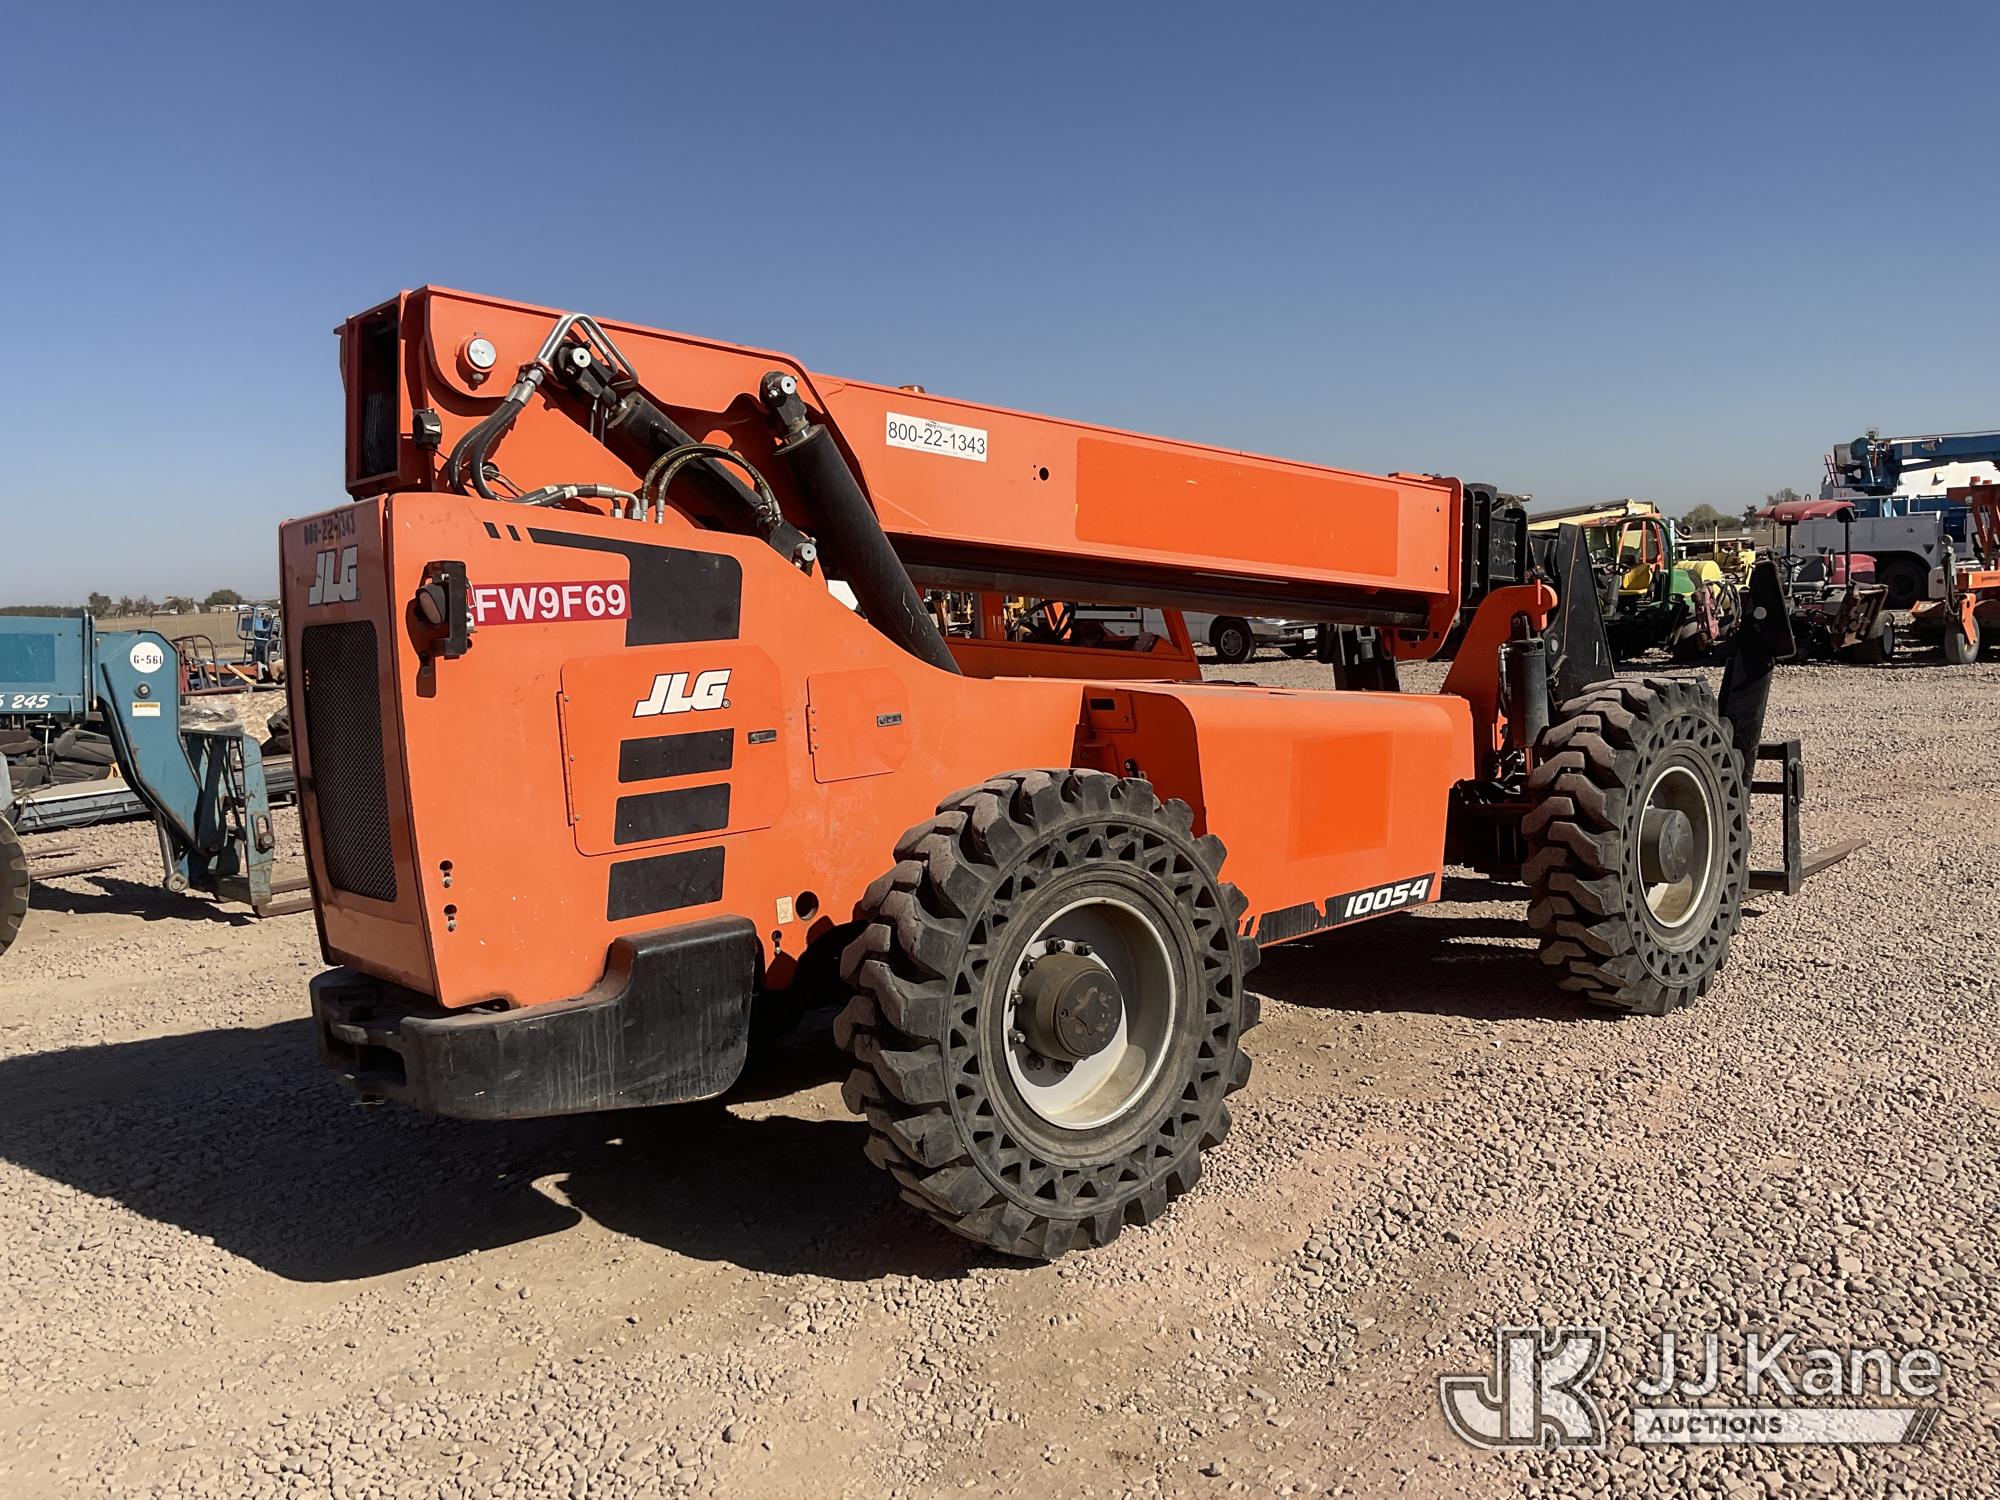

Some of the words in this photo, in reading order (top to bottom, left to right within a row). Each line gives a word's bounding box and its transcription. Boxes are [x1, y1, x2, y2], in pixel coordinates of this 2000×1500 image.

[888, 421, 985, 455] 800-22-1343
[308, 544, 359, 608] JLG
[11, 694, 51, 709] 245
[632, 668, 732, 718] JLG
[1344, 878, 1429, 918] 10054
